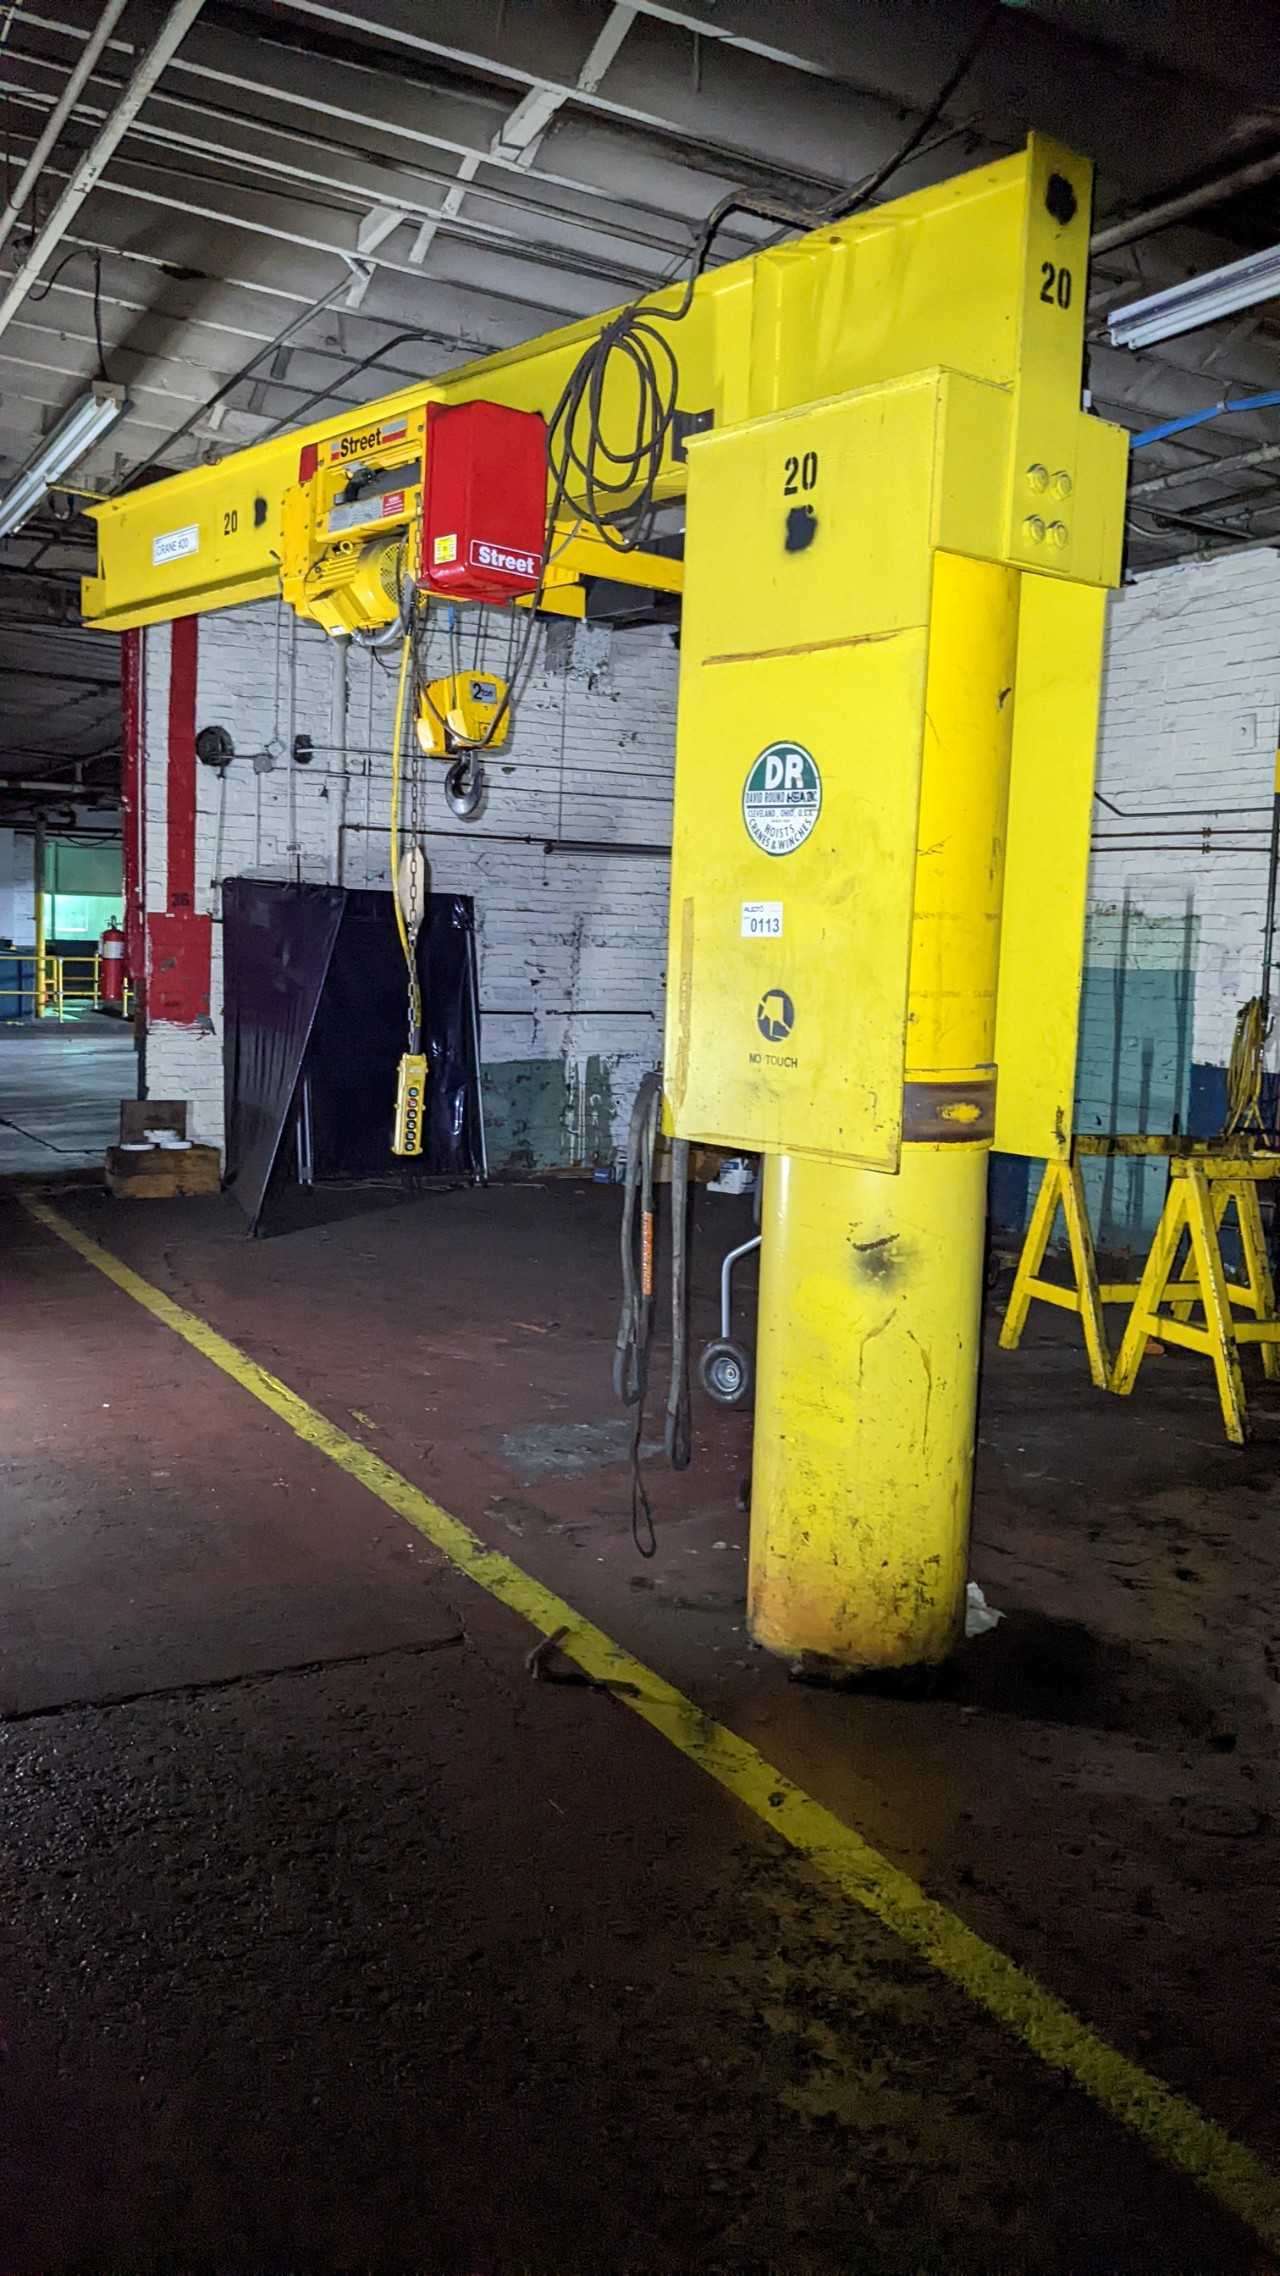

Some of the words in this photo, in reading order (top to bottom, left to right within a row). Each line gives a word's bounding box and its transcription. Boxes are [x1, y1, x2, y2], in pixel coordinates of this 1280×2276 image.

[1040, 261, 1072, 310] 20
[340, 428, 381, 458] Street
[784, 451, 818, 497] 20
[223, 509, 238, 536] 20
[478, 545, 535, 575] Street
[764, 753, 804, 790] DR
[748, 818, 771, 848] CRANES
[778, 818, 812, 850] WINCHES
[764, 823, 795, 838] HOISTS
[751, 918, 780, 933] 0113
[749, 1053, 762, 1064] NO
[765, 1054, 798, 1068] TOUCH
